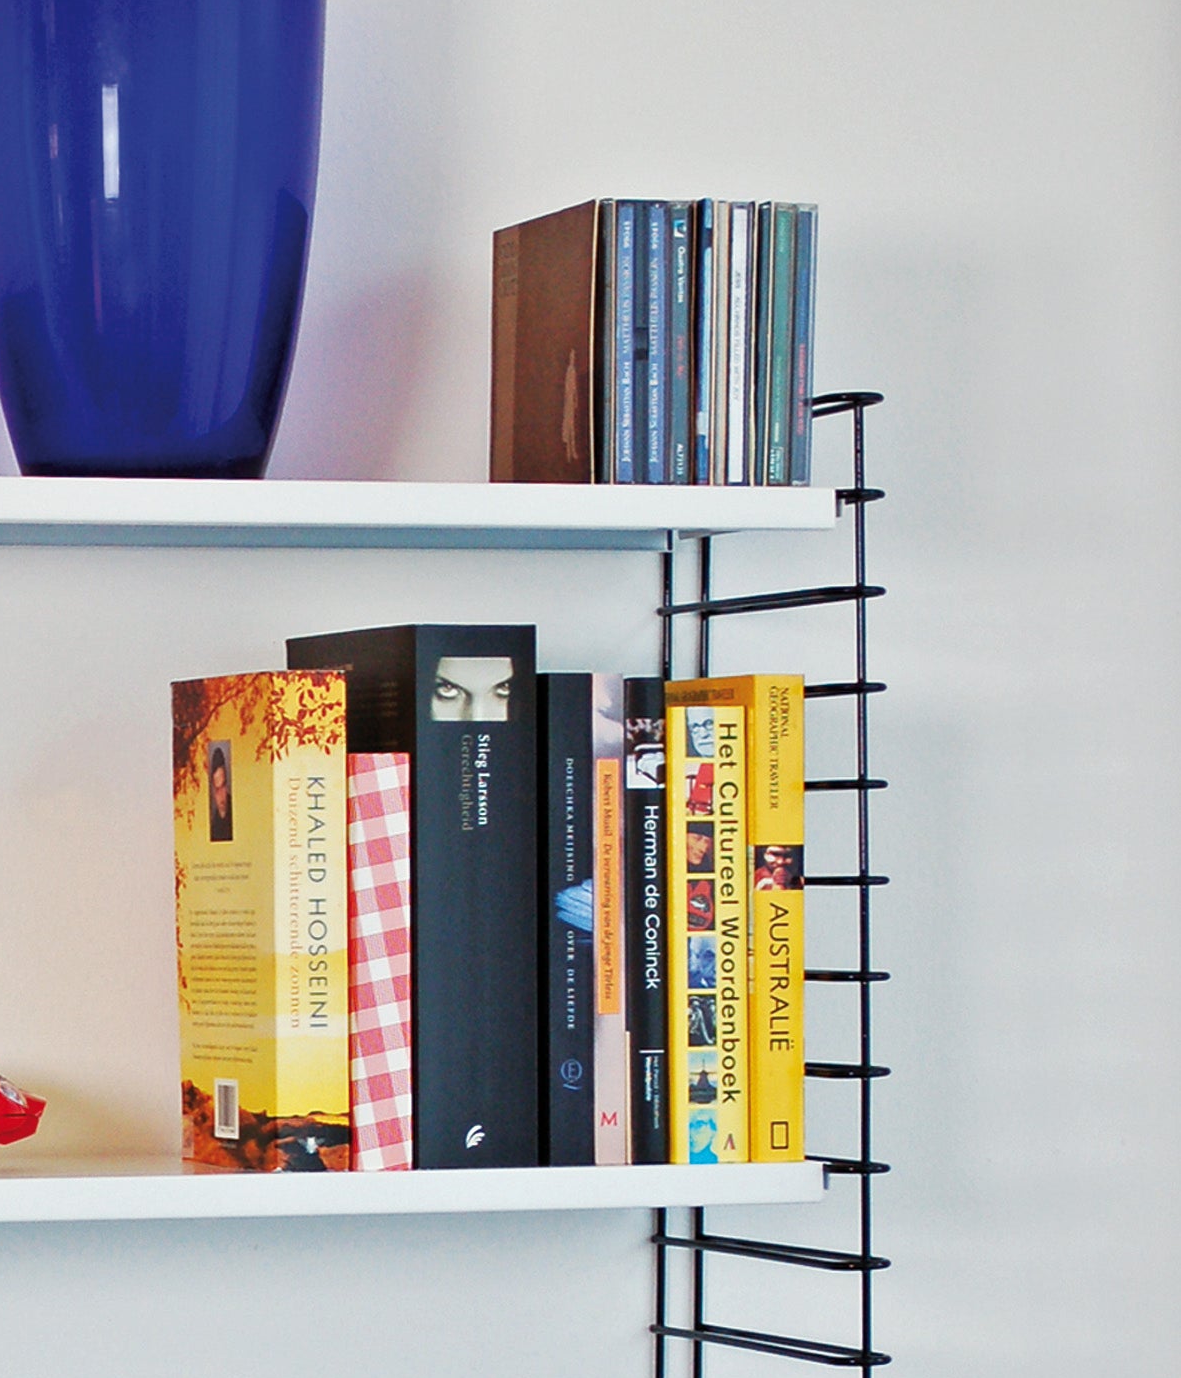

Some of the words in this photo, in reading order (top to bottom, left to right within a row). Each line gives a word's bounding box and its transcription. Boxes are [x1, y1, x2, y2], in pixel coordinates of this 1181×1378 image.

[719, 723, 738, 769] Het
[769, 686, 779, 754] GEOGRAPHIC
[779, 687, 790, 738] NATIONAL
[458, 734, 475, 831] Gerechtigheid
[474, 734, 491, 769] Stieg
[287, 777, 302, 848] Duizend
[307, 776, 327, 884] KHALED
[478, 772, 491, 826] Larsson
[643, 805, 661, 878] Herman
[720, 786, 739, 905] Cultureel
[289, 855, 304, 958] schitterende
[644, 884, 661, 909] de
[307, 898, 328, 1029] HOSSEINI
[566, 930, 575, 961] OVER
[566, 969, 575, 984] DE
[644, 914, 661, 989] Coninck
[769, 903, 795, 1052] AUSTRALIË
[291, 965, 301, 1029] zonnen
[566, 988, 575, 1030] LIEFDE
[721, 916, 741, 1104] Woordenboek
